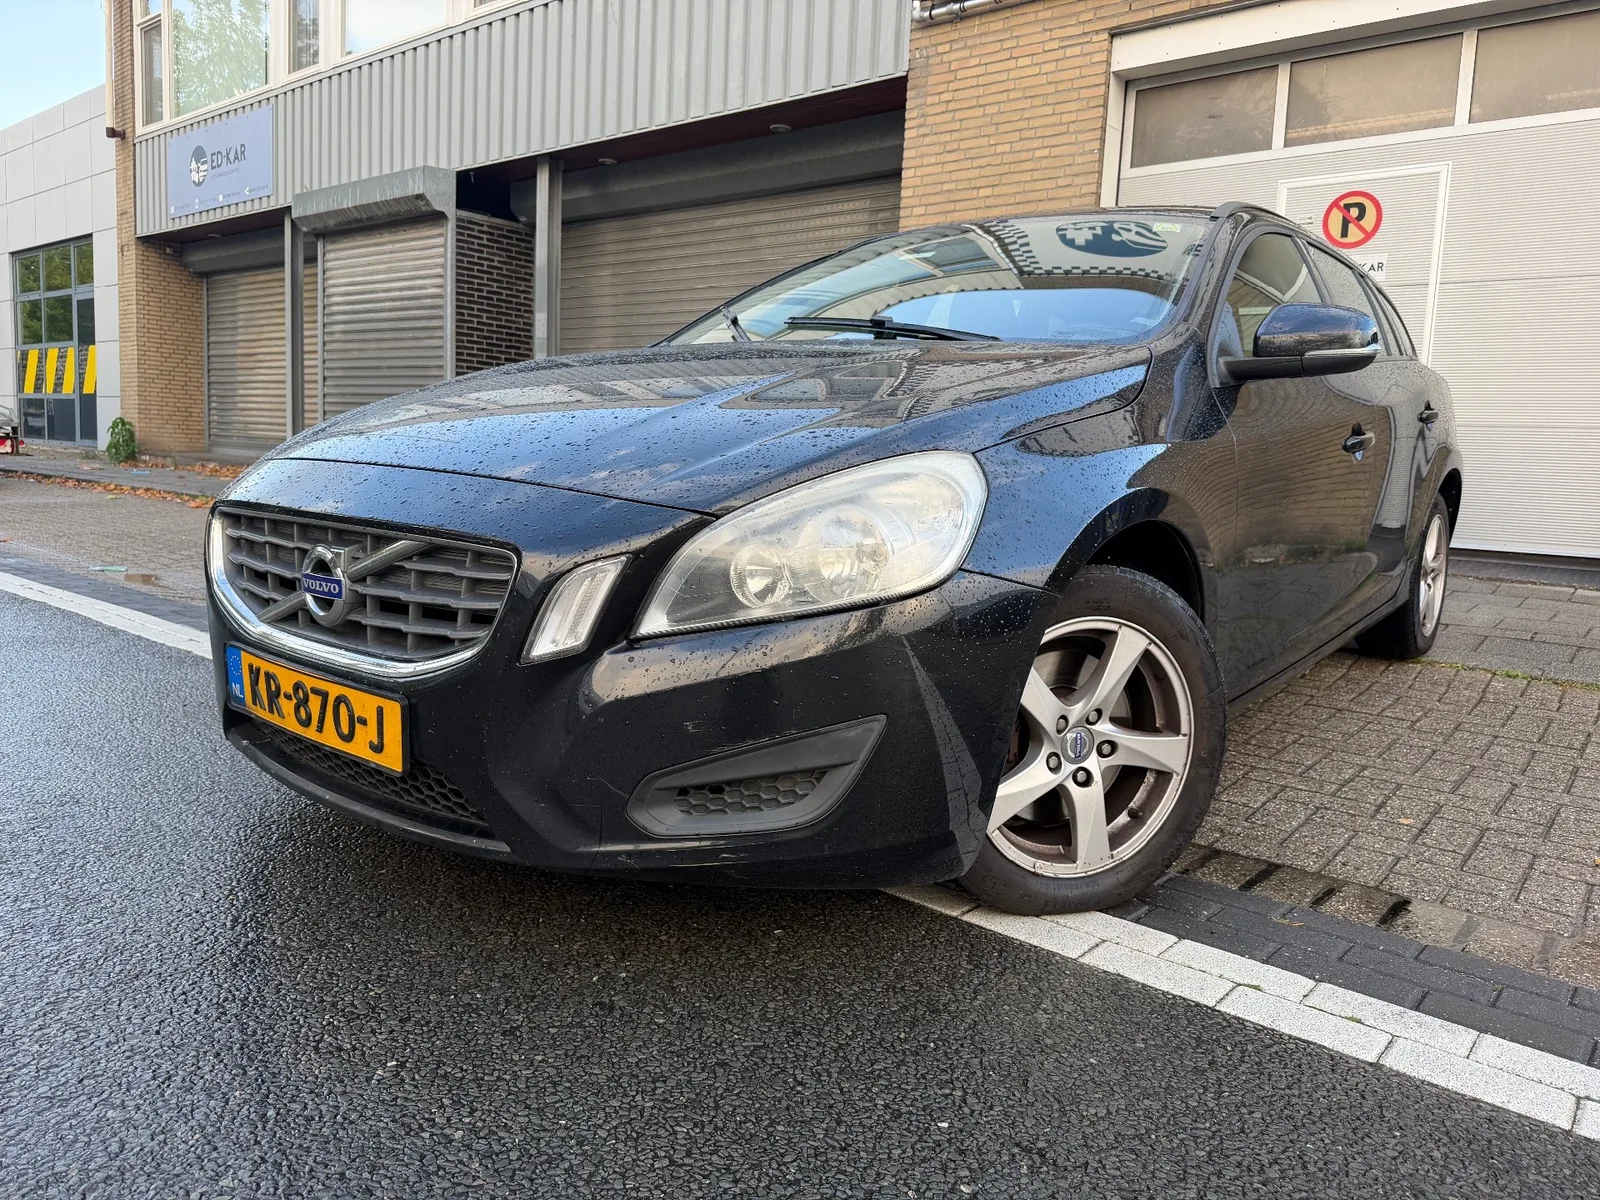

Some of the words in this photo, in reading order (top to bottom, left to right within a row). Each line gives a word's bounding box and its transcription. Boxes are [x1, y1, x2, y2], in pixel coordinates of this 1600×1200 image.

[303, 578, 339, 594] VOLVO
[232, 682, 244, 698] NL
[248, 662, 385, 754] KR-870-J
